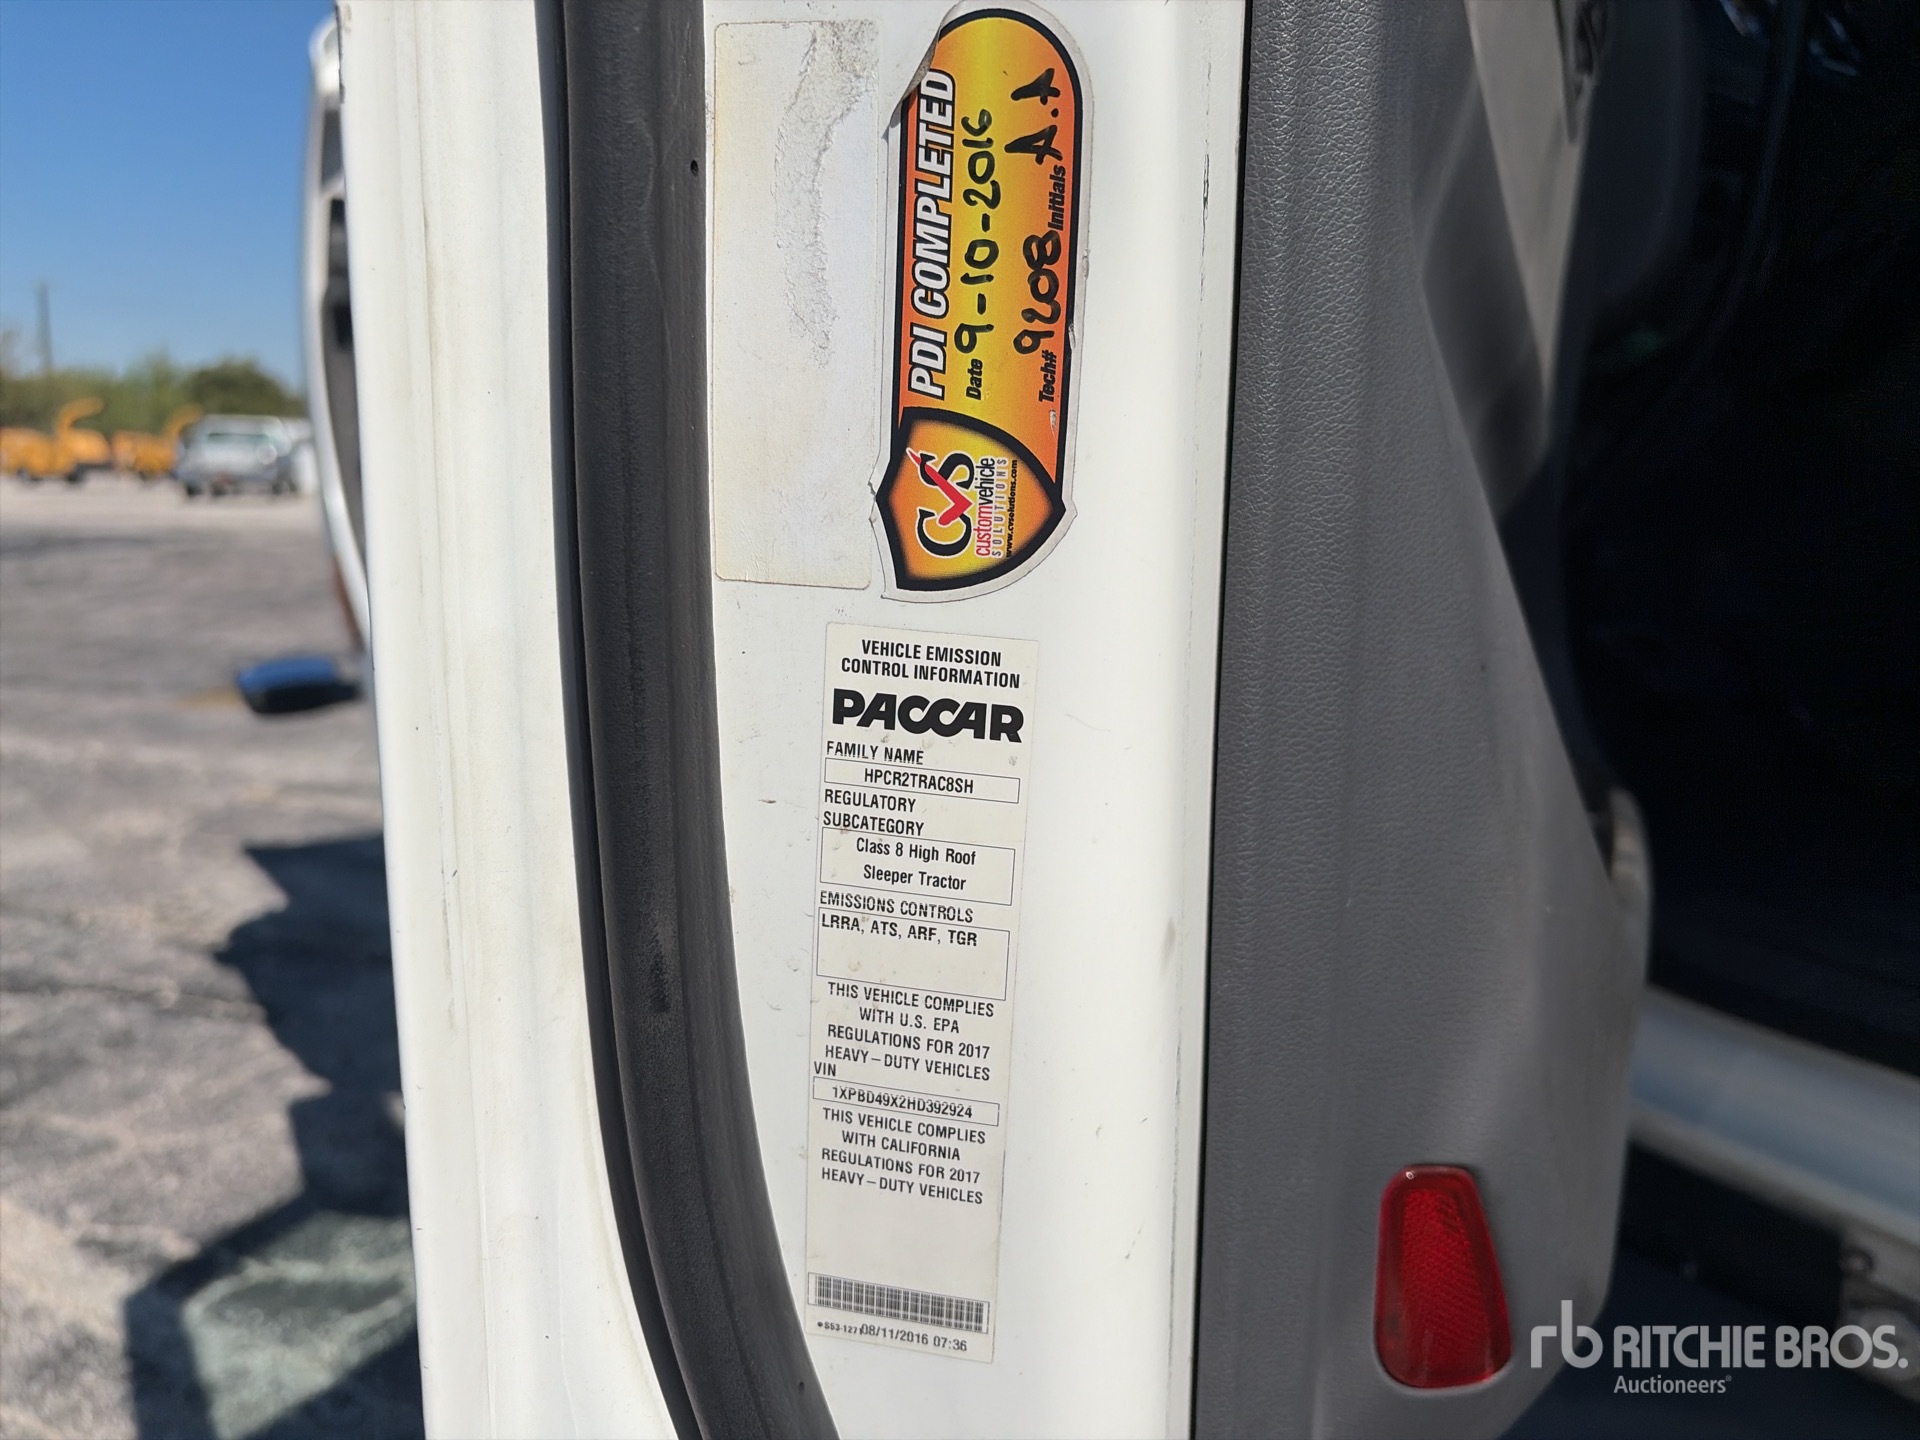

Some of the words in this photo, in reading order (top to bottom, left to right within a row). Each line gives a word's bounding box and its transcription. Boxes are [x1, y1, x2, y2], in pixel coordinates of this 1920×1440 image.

[911, 68, 956, 319] COMPLETED
[1048, 165, 1066, 231] Initials
[954, 109, 1001, 353] 9-10-2016
[1013, 230, 1061, 354] 9208
[908, 322, 947, 400] PDI
[1039, 350, 1057, 402] Tech#
[966, 358, 983, 400] Date
[992, 459, 1007, 556] SOLUTIONS
[862, 639, 921, 660] VEHICLE
[926, 645, 1001, 667] EMISSION
[841, 657, 909, 679] CONTROL
[914, 664, 1020, 689] INFORMATION
[832, 688, 1024, 743] PACCAR
[827, 740, 878, 760] FAMILY
[884, 746, 924, 765] NAME
[864, 768, 974, 794] HPCR2TRAC8SH
[824, 789, 916, 813] REGULATORY
[823, 811, 924, 836] SUBCATEGORY
[856, 837, 890, 856] Class
[895, 842, 904, 857] 8
[909, 844, 939, 862] High
[945, 848, 976, 865] Roof
[863, 864, 913, 885] Sleeper
[918, 871, 966, 890] Tractor
[820, 890, 895, 914] EMISSIONS
[900, 900, 974, 923] CONTROLS
[821, 913, 865, 934] LRRA,
[870, 920, 902, 940] ATS,
[907, 925, 941, 945] ARF,
[948, 929, 977, 947] TGR
[828, 982, 858, 999] THIS
[864, 986, 920, 1008] VEHICLE
[924, 995, 994, 1017] COMPLIES
[859, 1007, 894, 1025] WITH
[899, 1013, 927, 1030] U.S.
[933, 1017, 960, 1034] EPA
[828, 1024, 921, 1051] REGULATIONS
[926, 1038, 953, 1055] FOR
[958, 1042, 990, 1060] 2017
[814, 1061, 837, 1077] VIN
[925, 1059, 990, 1081] VEHICLES
[832, 1086, 972, 1118] 1XPBD49X2HD392924
[823, 1107, 853, 1124] THIS
[858, 1113, 912, 1134] VEHICLE
[917, 1122, 986, 1145] COMPLIES
[842, 1130, 876, 1148] WITH
[881, 1137, 961, 1161] CALIFORNIA
[821, 1148, 913, 1174] REGULATIONS
[918, 1163, 945, 1180] FOR
[949, 1168, 980, 1184] 2017
[919, 1182, 983, 1205] VEHICLES
[861, 1323, 929, 1345] 08/11/2016
[933, 1335, 967, 1352] 07:36
